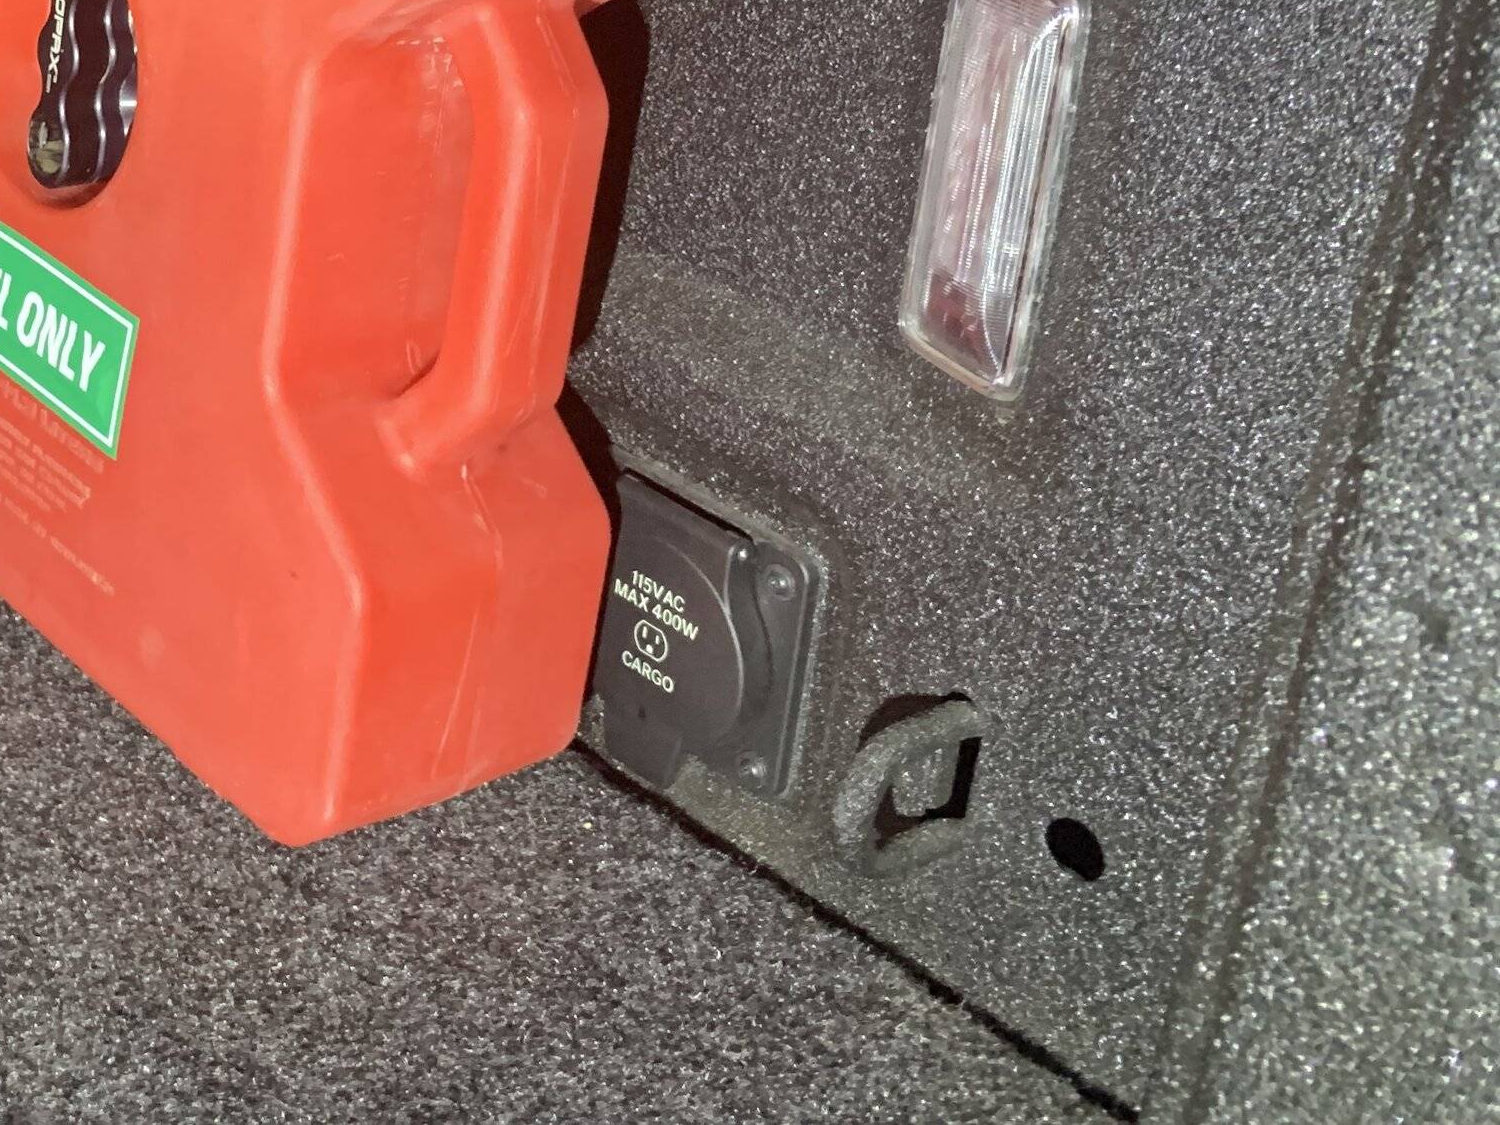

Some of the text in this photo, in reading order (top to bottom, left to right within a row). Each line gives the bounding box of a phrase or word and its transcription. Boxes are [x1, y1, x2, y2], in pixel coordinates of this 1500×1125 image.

[16, 291, 106, 392] ONLY
[614, 579, 699, 641] MAX 400W
[632, 570, 685, 613] 115VAC
[622, 650, 674, 693] CARGO
